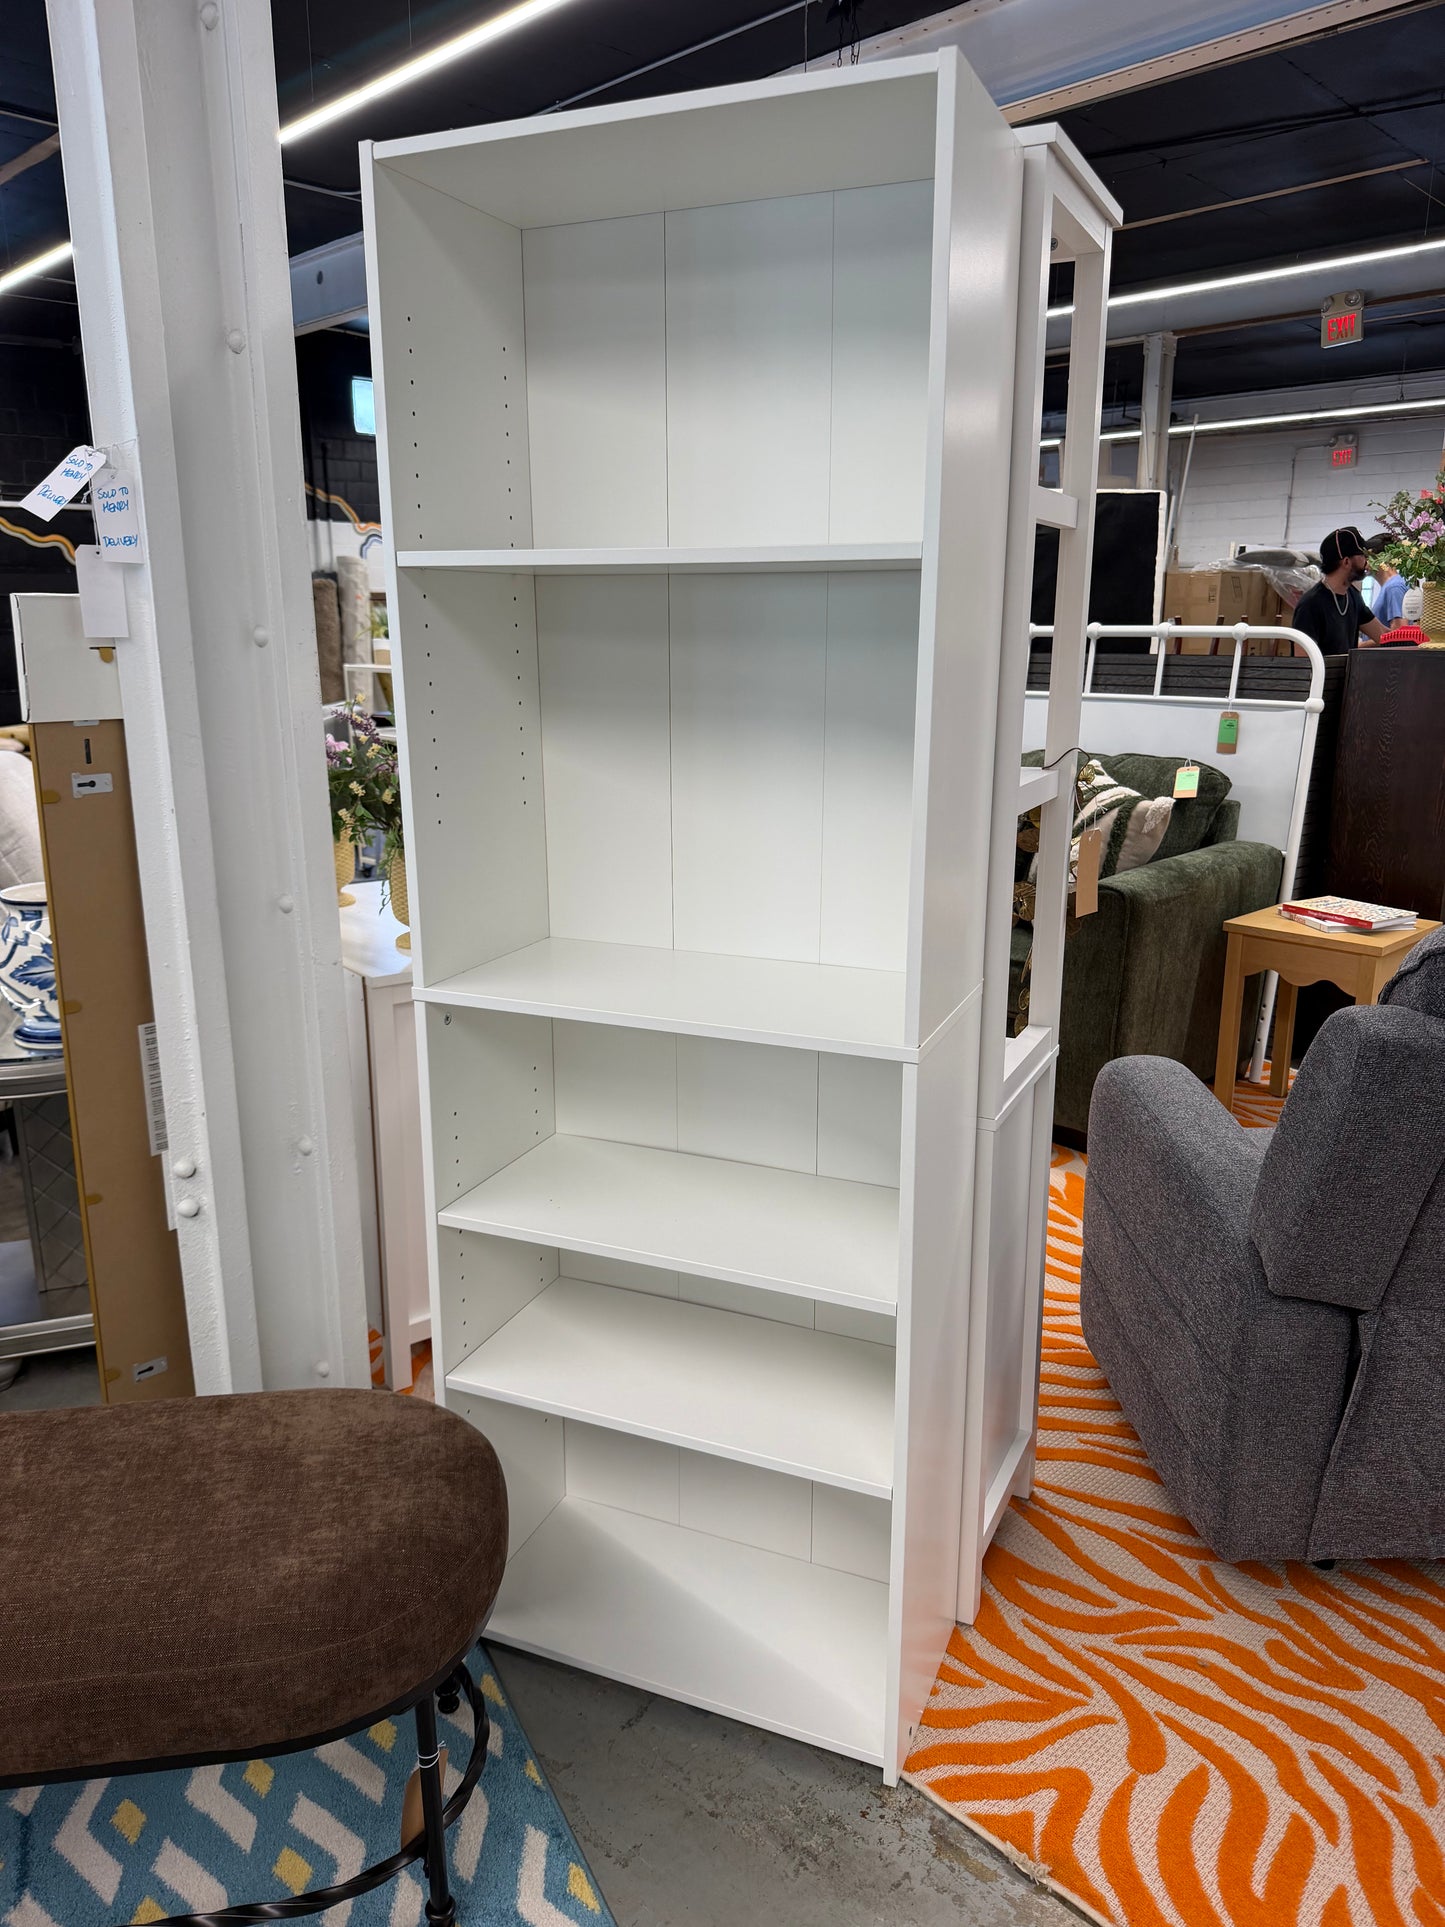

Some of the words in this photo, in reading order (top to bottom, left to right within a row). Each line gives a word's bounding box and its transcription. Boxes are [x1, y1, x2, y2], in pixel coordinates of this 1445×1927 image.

[1327, 313, 1357, 341] EXIT
[1332, 448, 1352, 467] EXIT
[85, 461, 93, 471] TO
[97, 487, 116, 500] SOLD
[119, 486, 129, 496] TO
